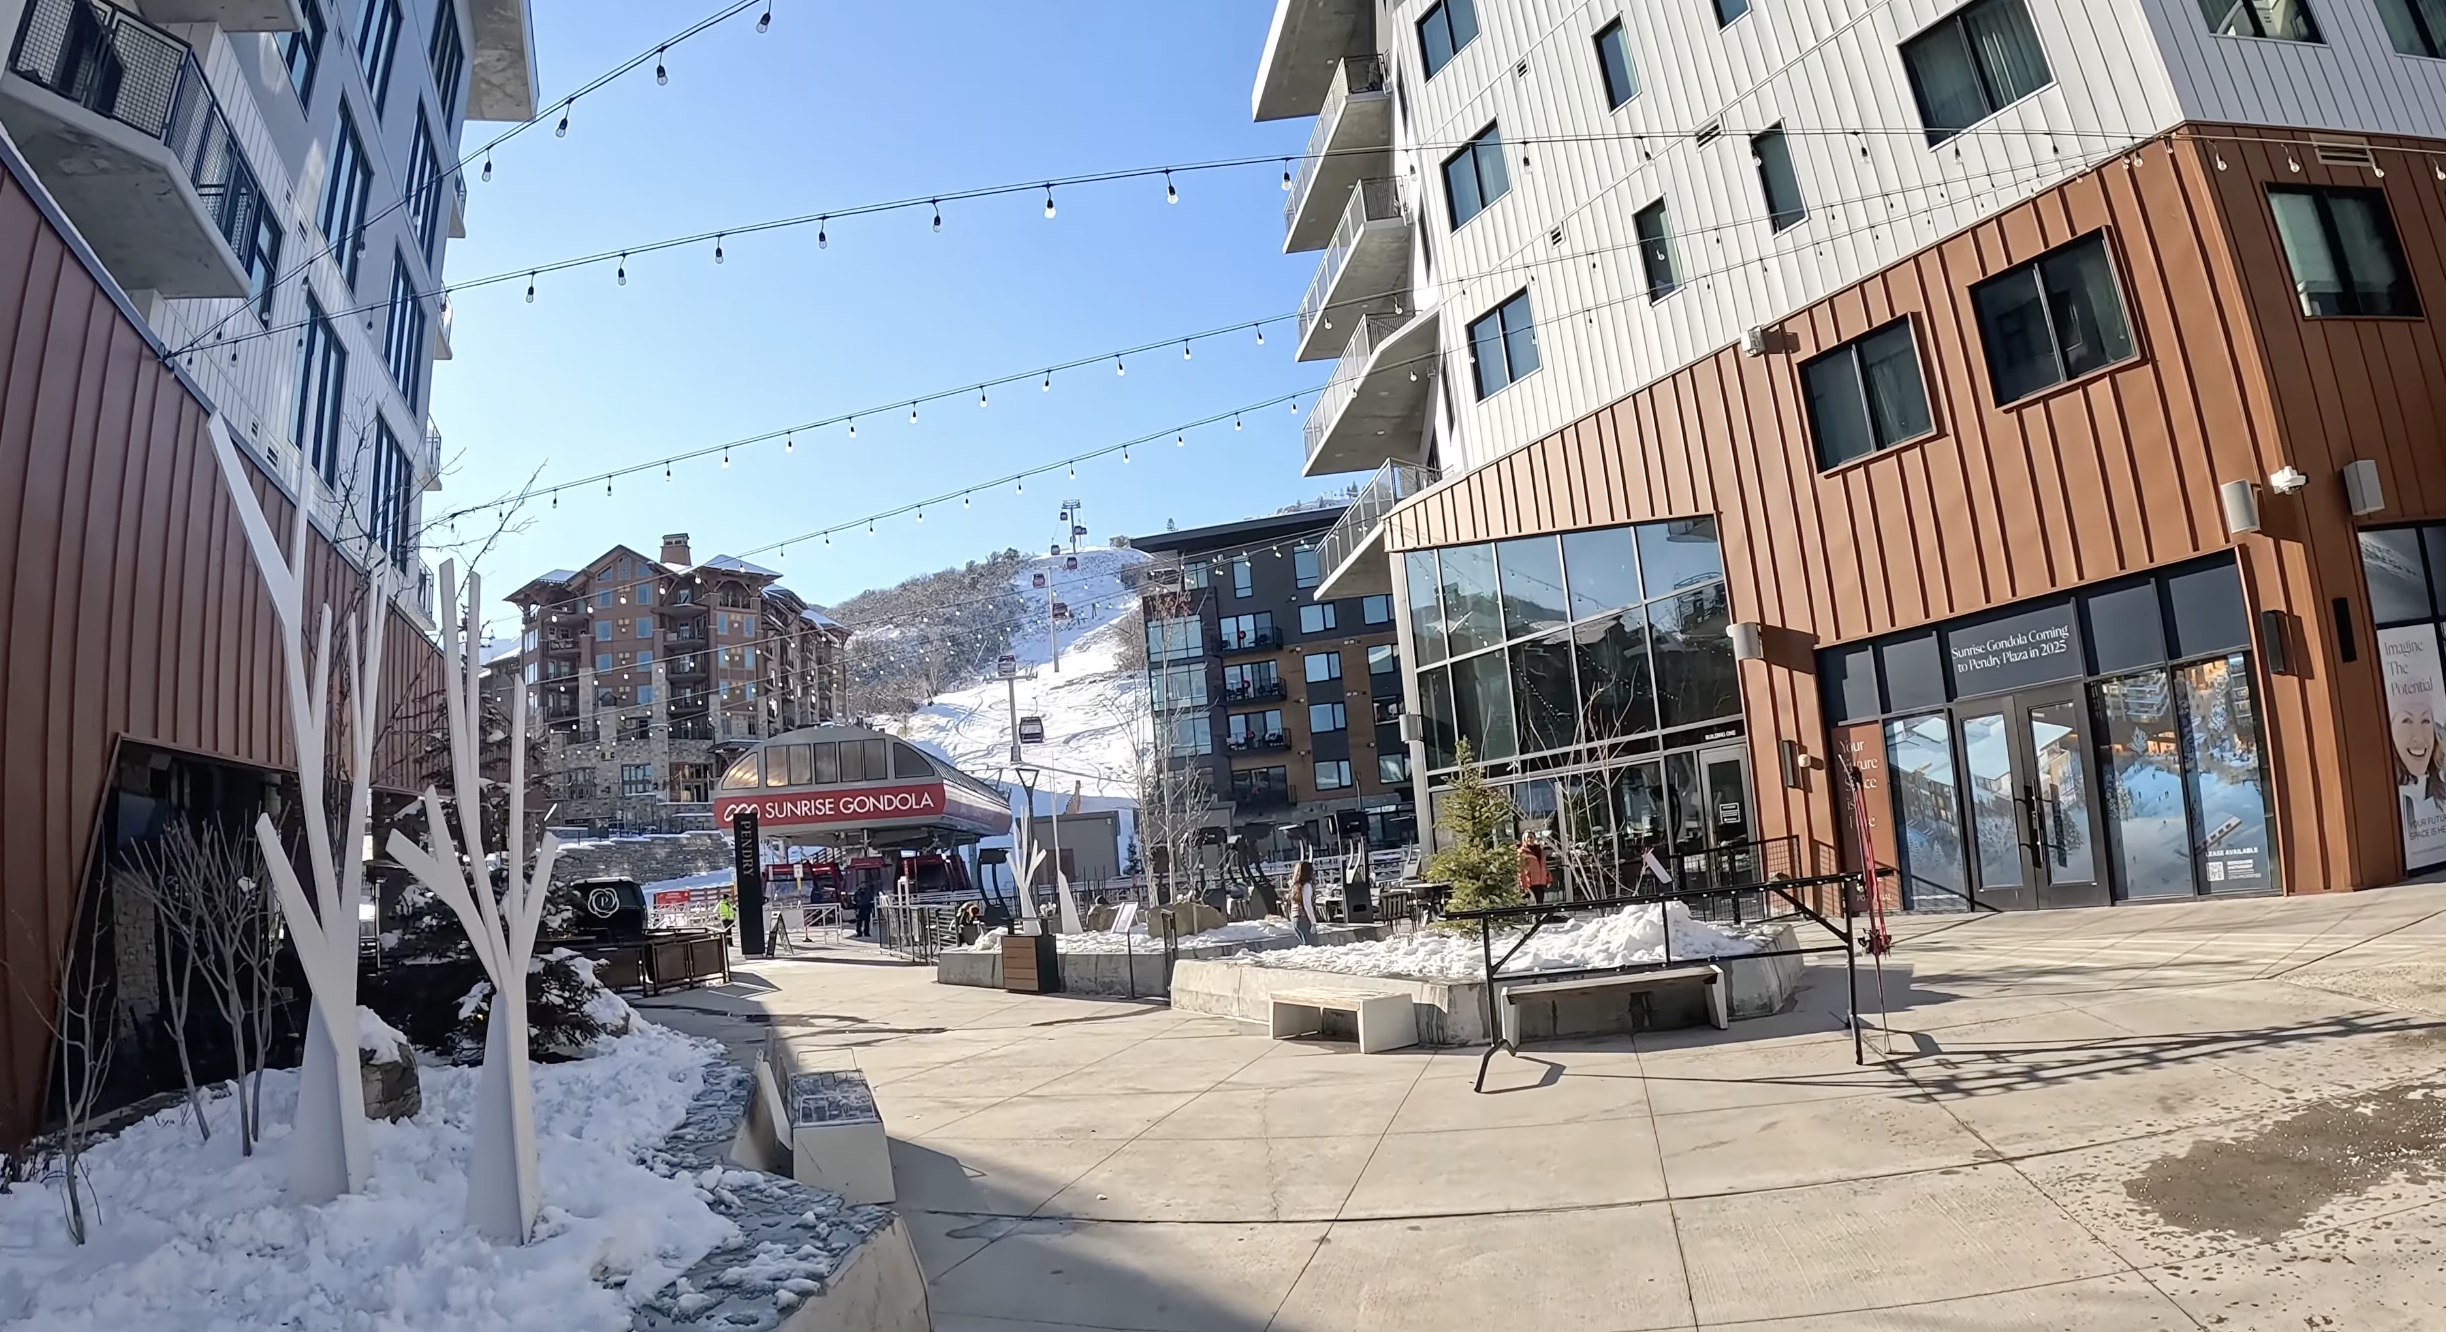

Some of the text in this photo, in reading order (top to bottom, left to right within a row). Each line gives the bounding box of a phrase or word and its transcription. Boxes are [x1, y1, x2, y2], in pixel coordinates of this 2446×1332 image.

[1951, 625, 2070, 660] Sunrise Gondola Coming
[2384, 640, 2424, 657] Imagine
[1957, 640, 2067, 673] to Pendry Plaza in 2025
[2388, 661, 2409, 676] The
[2391, 676, 2434, 697] Potential
[1840, 740, 1865, 754] Your
[765, 798, 835, 819] SUNRISE
[839, 791, 935, 814] GONDOLA
[2408, 818, 2427, 829] YOUR
[740, 820, 755, 877] PENDRY
[2225, 846, 2259, 856] AVAILABLE
